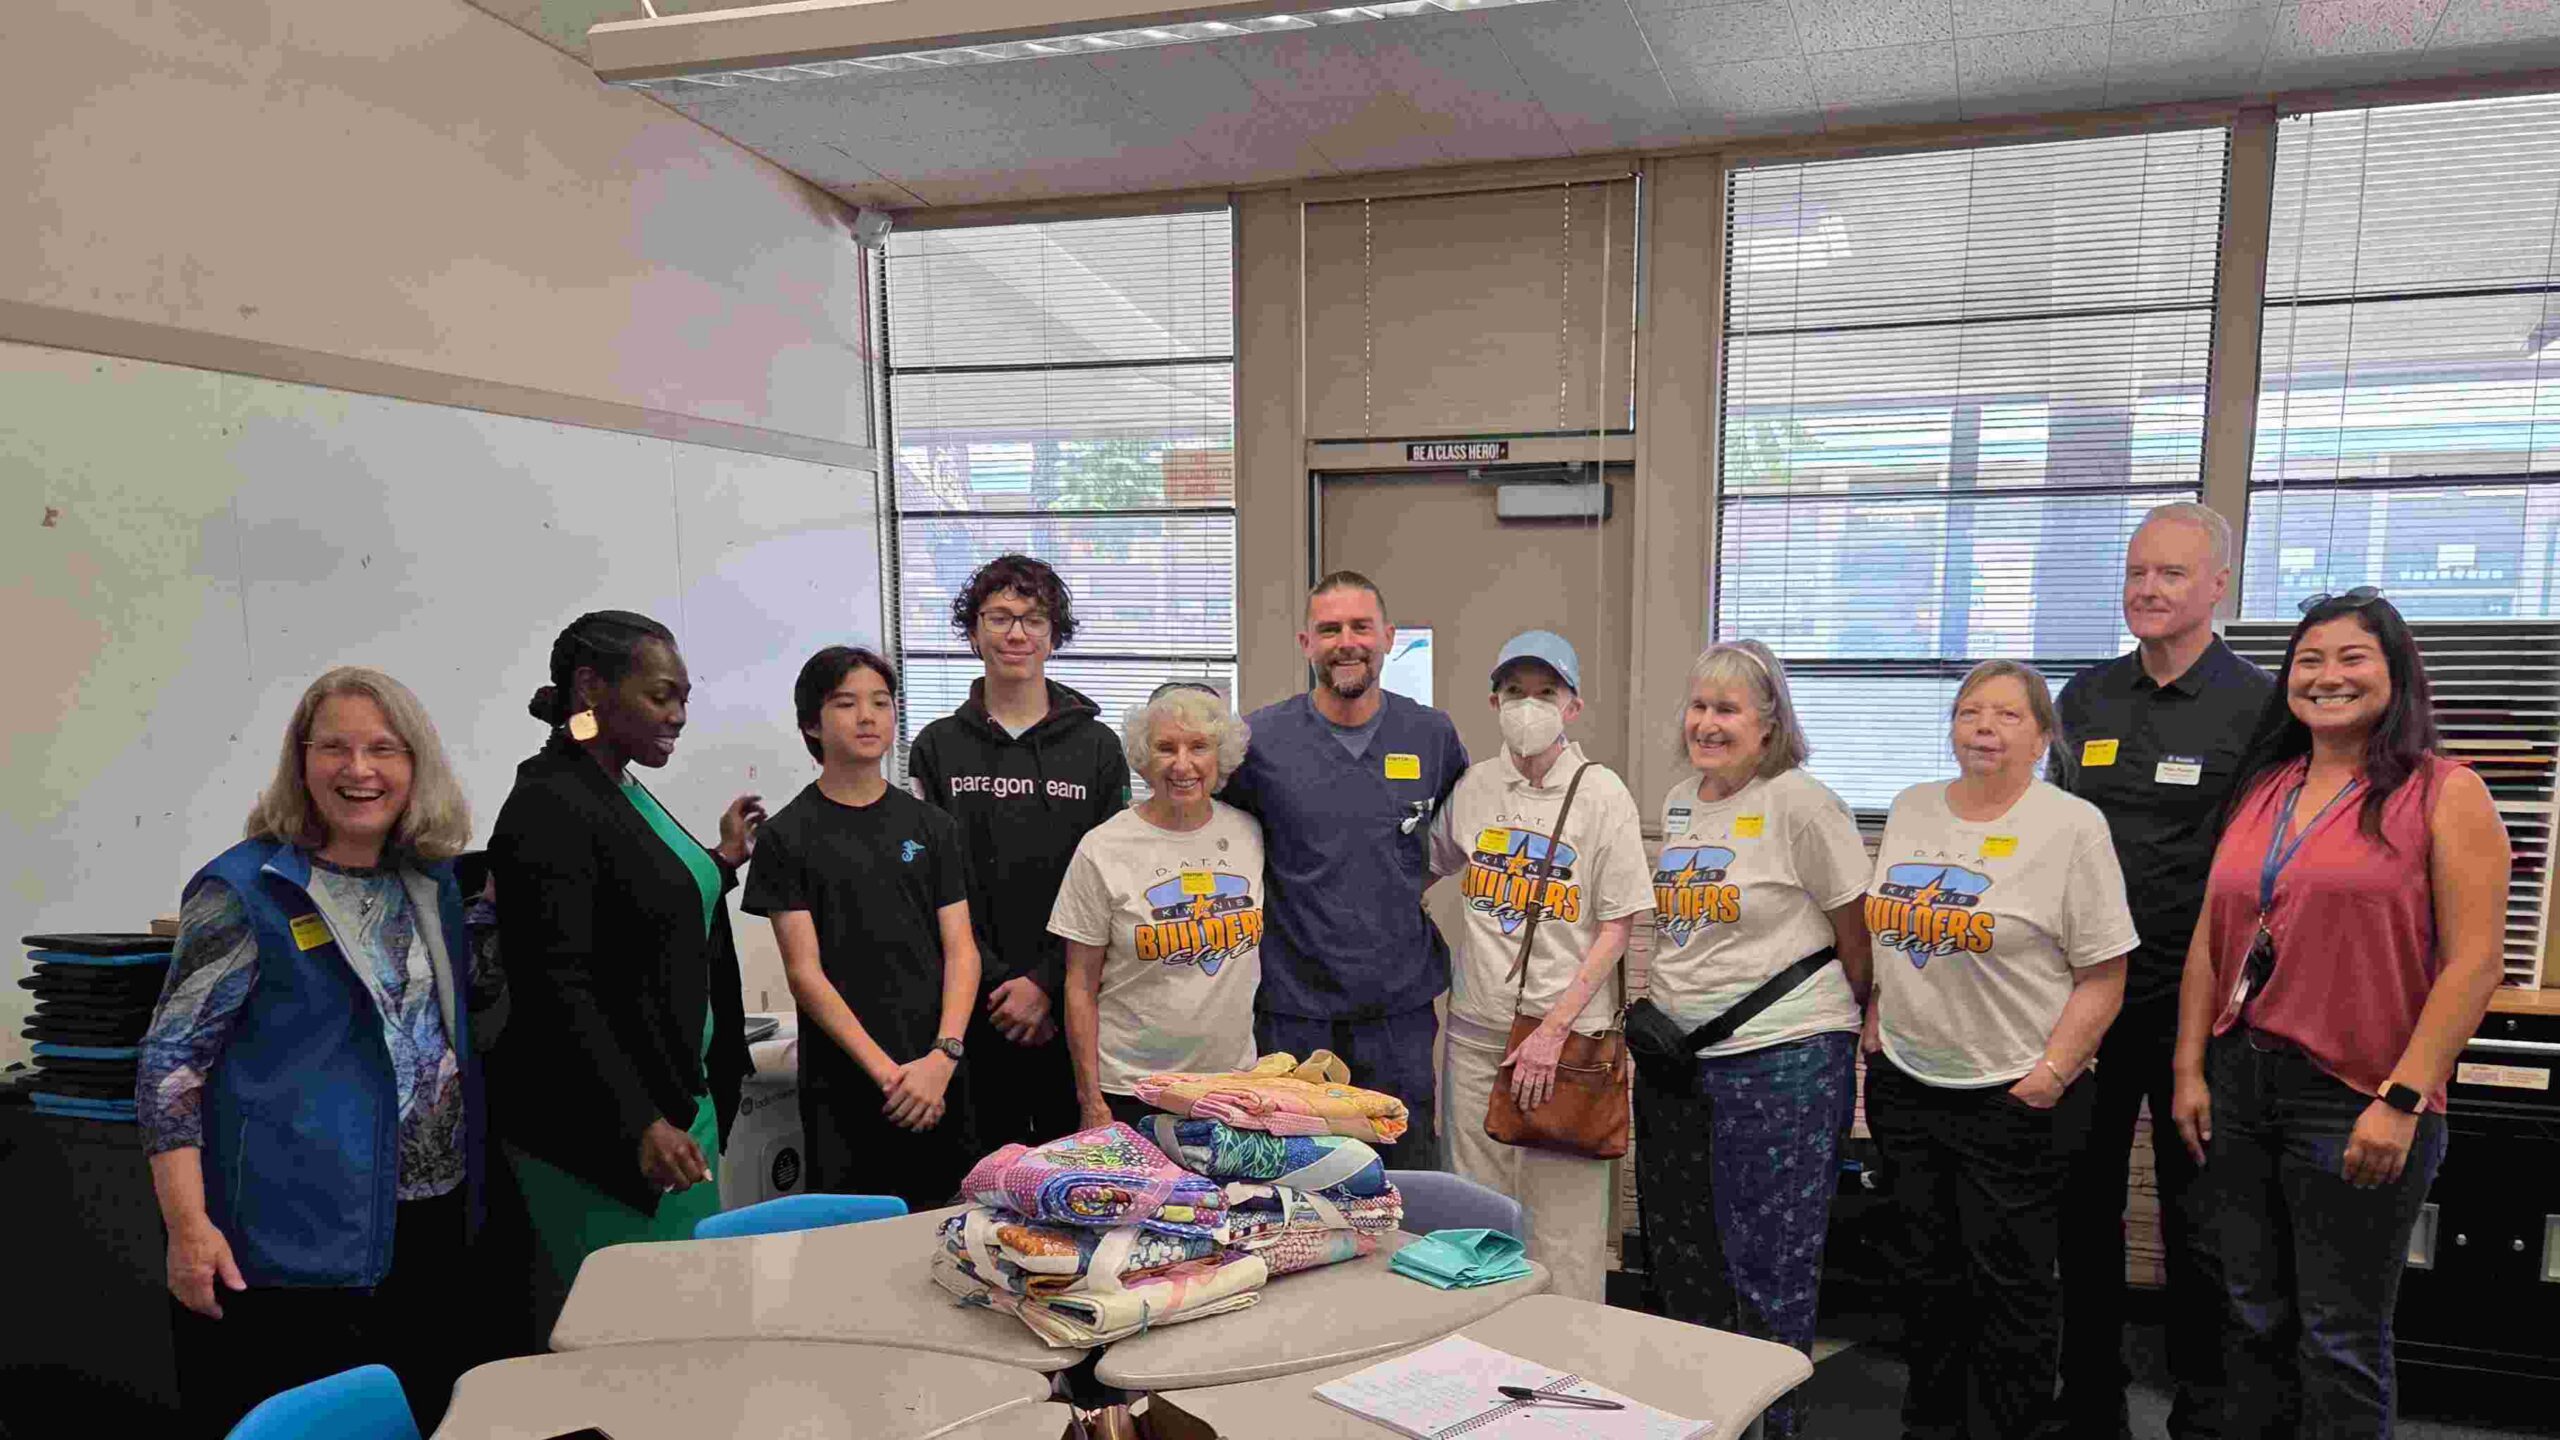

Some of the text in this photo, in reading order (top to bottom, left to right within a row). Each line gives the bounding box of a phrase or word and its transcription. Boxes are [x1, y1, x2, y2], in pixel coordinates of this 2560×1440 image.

[1413, 443, 1500, 460] BE A CLASS HERO!
[951, 775, 1086, 800] paragon eam
